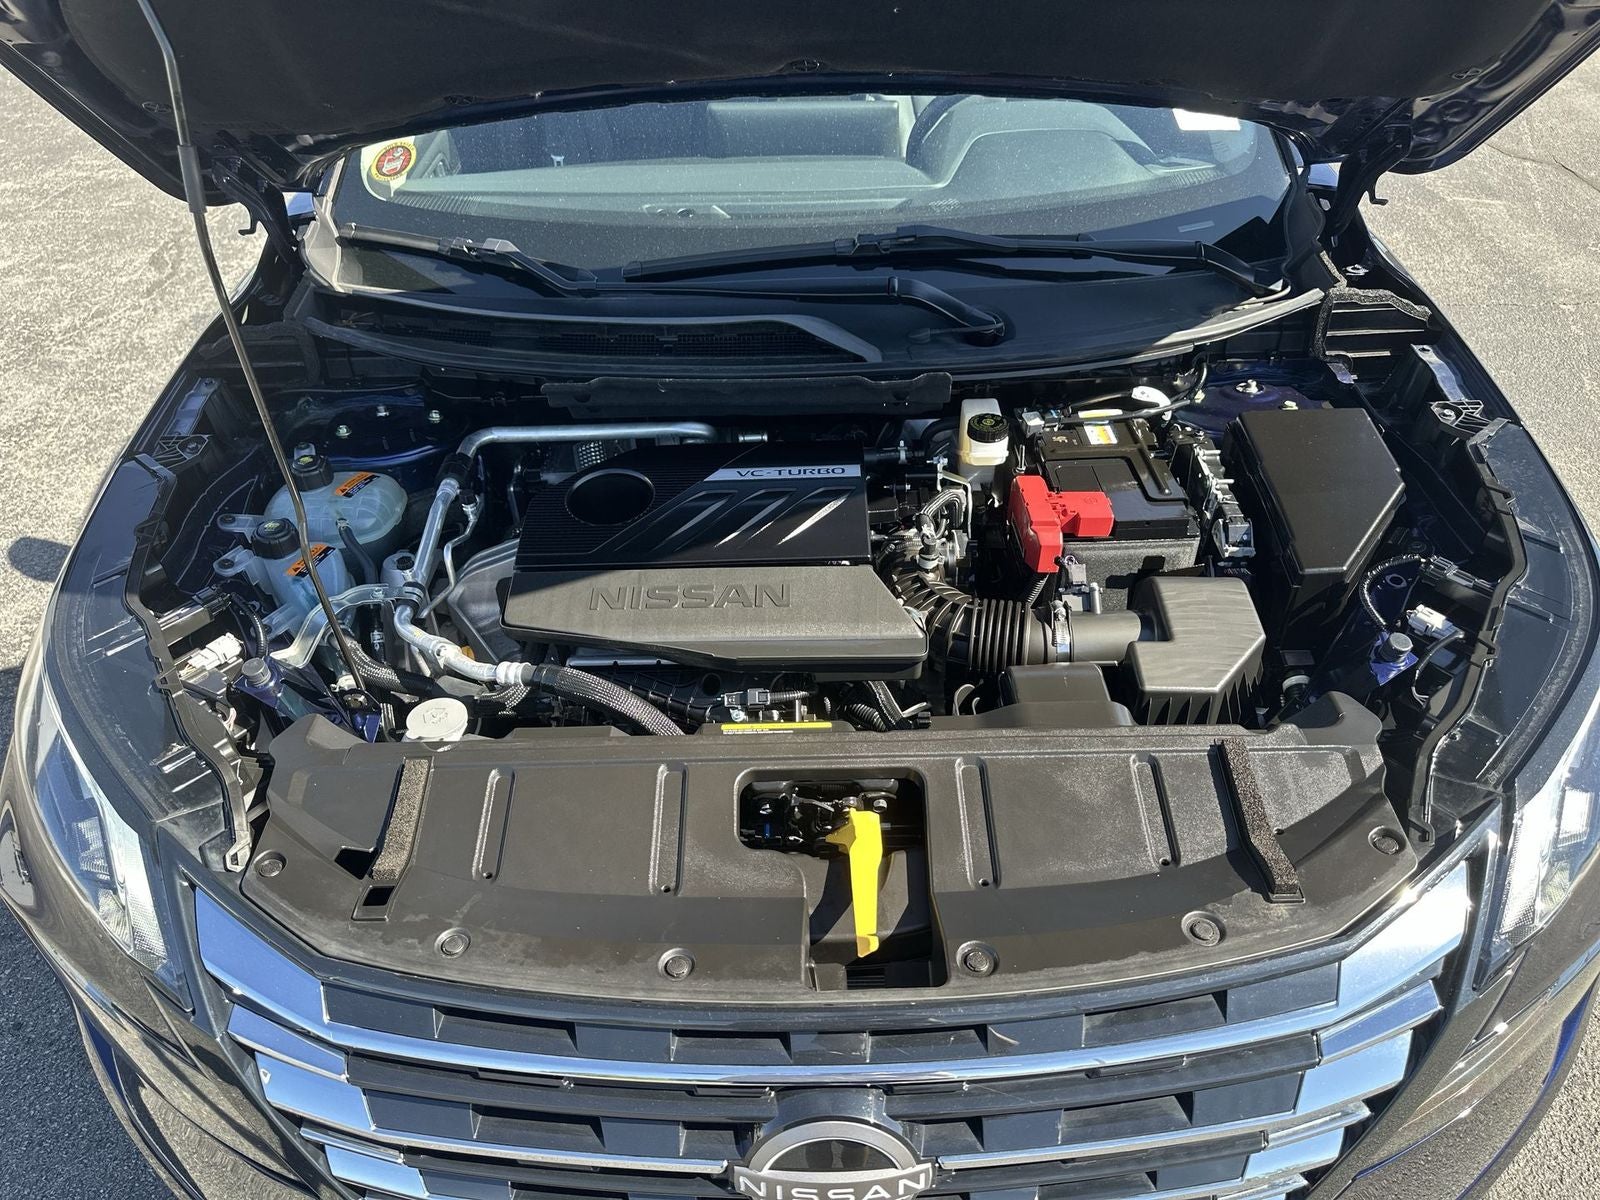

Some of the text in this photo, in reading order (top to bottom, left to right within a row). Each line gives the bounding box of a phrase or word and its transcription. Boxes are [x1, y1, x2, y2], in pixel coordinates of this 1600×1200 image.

[736, 467, 846, 477] VC-TURBO
[589, 583, 791, 611] NISSAN
[739, 1172, 926, 1200] NISSAN
